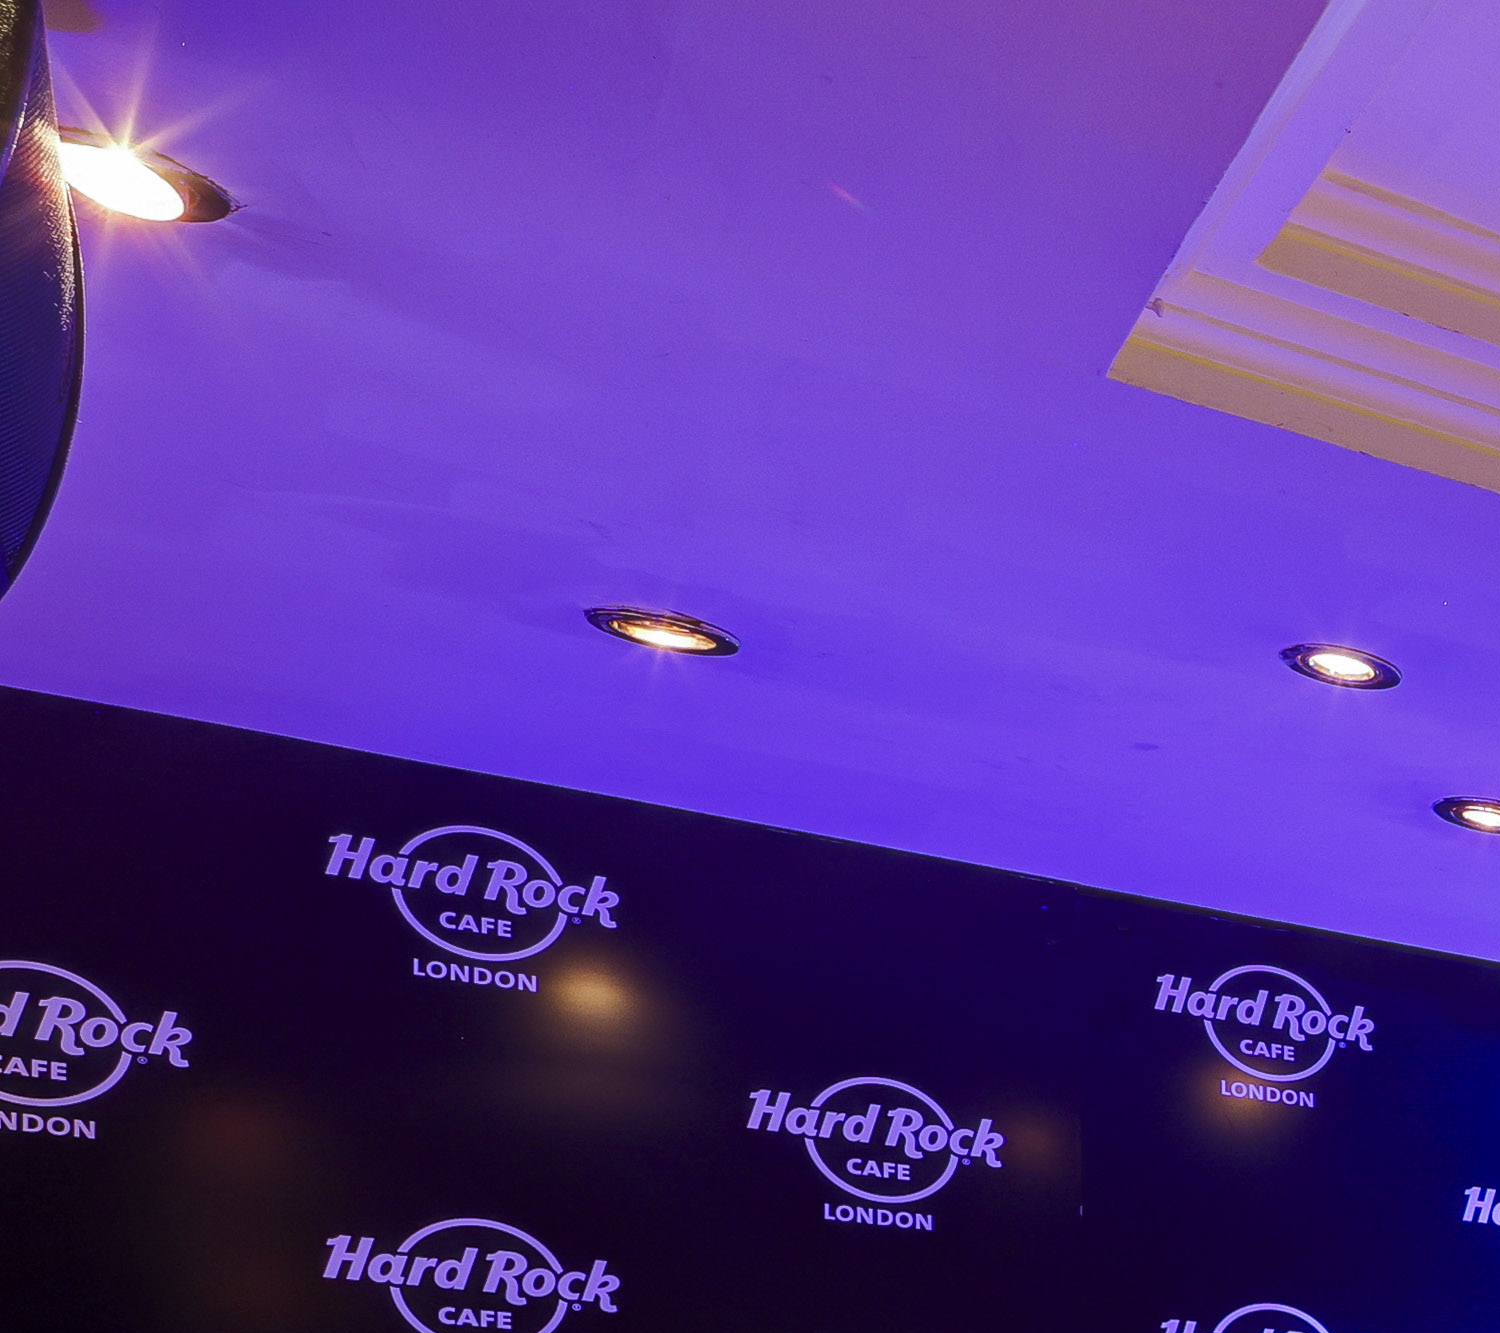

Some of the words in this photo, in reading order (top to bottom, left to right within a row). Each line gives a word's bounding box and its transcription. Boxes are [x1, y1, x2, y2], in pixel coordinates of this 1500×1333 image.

[323, 832, 480, 896] Hard
[481, 858, 620, 929] Rock
[438, 910, 512, 938] CAFE
[411, 957, 537, 993] LONDON
[1152, 973, 1270, 1026] Hard
[1271, 992, 1375, 1052] Rock
[32, 995, 193, 1068] Rock
[1239, 1038, 1295, 1062] CAFE
[0, 1055, 67, 1081] AFE
[1220, 1078, 1314, 1109] LONDON
[0, 1108, 96, 1140] NDON
[745, 1088, 882, 1144] Hard
[883, 1106, 1004, 1169] Rock
[846, 1157, 911, 1181] CAFE
[823, 1202, 933, 1232] LONDON
[321, 1234, 480, 1290] Hard
[481, 1249, 620, 1314] Rock
[437, 1305, 512, 1330] CAFE
